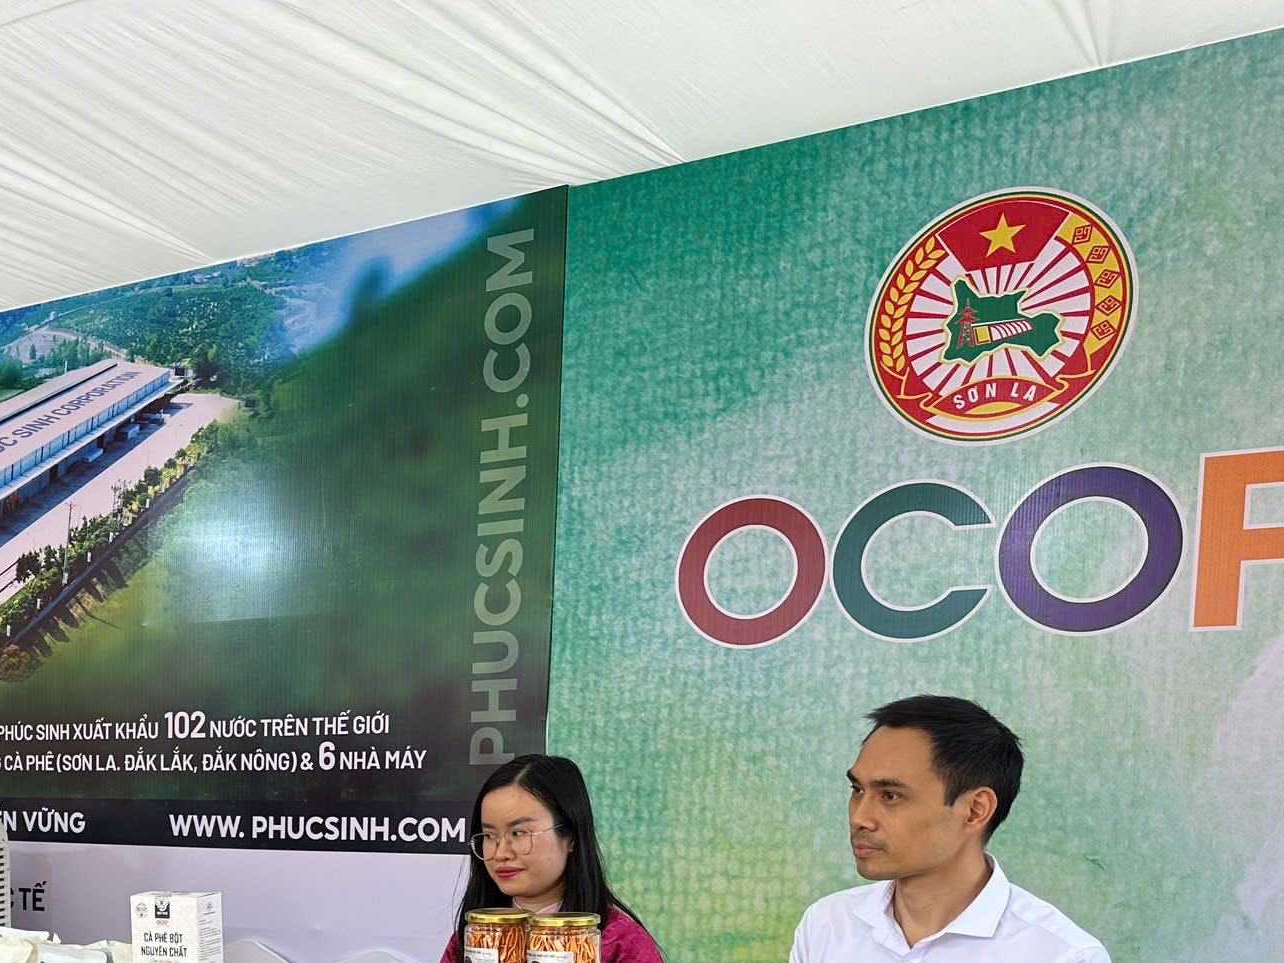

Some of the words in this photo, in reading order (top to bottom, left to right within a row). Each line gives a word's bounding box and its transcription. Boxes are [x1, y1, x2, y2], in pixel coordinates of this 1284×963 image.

[15, 414, 60, 439] SINH
[55, 371, 141, 417] CORPORATION
[952, 382, 1000, 411] SƠN
[1010, 383, 1038, 403] LA
[468, 228, 536, 766] PHUCSINH.COM
[36, 724, 69, 741] SINH
[72, 717, 112, 740] XUẤT
[116, 714, 158, 740] KHẨU
[165, 711, 205, 739] 102
[210, 716, 256, 738] NƯỚC
[261, 714, 308, 736] TRÊN
[313, 710, 349, 735] THẾ
[353, 711, 389, 735] GIỚI
[4, 752, 23, 771] CÀ
[26, 752, 53, 771] PHÊ
[56, 754, 93, 773] (SƠN
[124, 747, 157, 771] ĐẮK
[160, 746, 197, 773] LẮK,
[202, 746, 237, 772] ĐẮK
[241, 749, 297, 773] NÔNG)
[301, 752, 314, 771] &
[319, 741, 335, 770] 6
[340, 747, 380, 770] NHÀ
[385, 746, 426, 770] MÁY
[22, 809, 86, 833] VỮNG
[169, 814, 244, 838] WWW.
[252, 816, 466, 842] PHUCSINH.COM
[18, 881, 46, 912] TẾ
[141, 946, 167, 956] NGUYÊN
[170, 945, 187, 958] CHẤT
[144, 932, 153, 942] CÀ
[155, 933, 167, 943] PHÊ
[170, 933, 183, 944] BỘT
